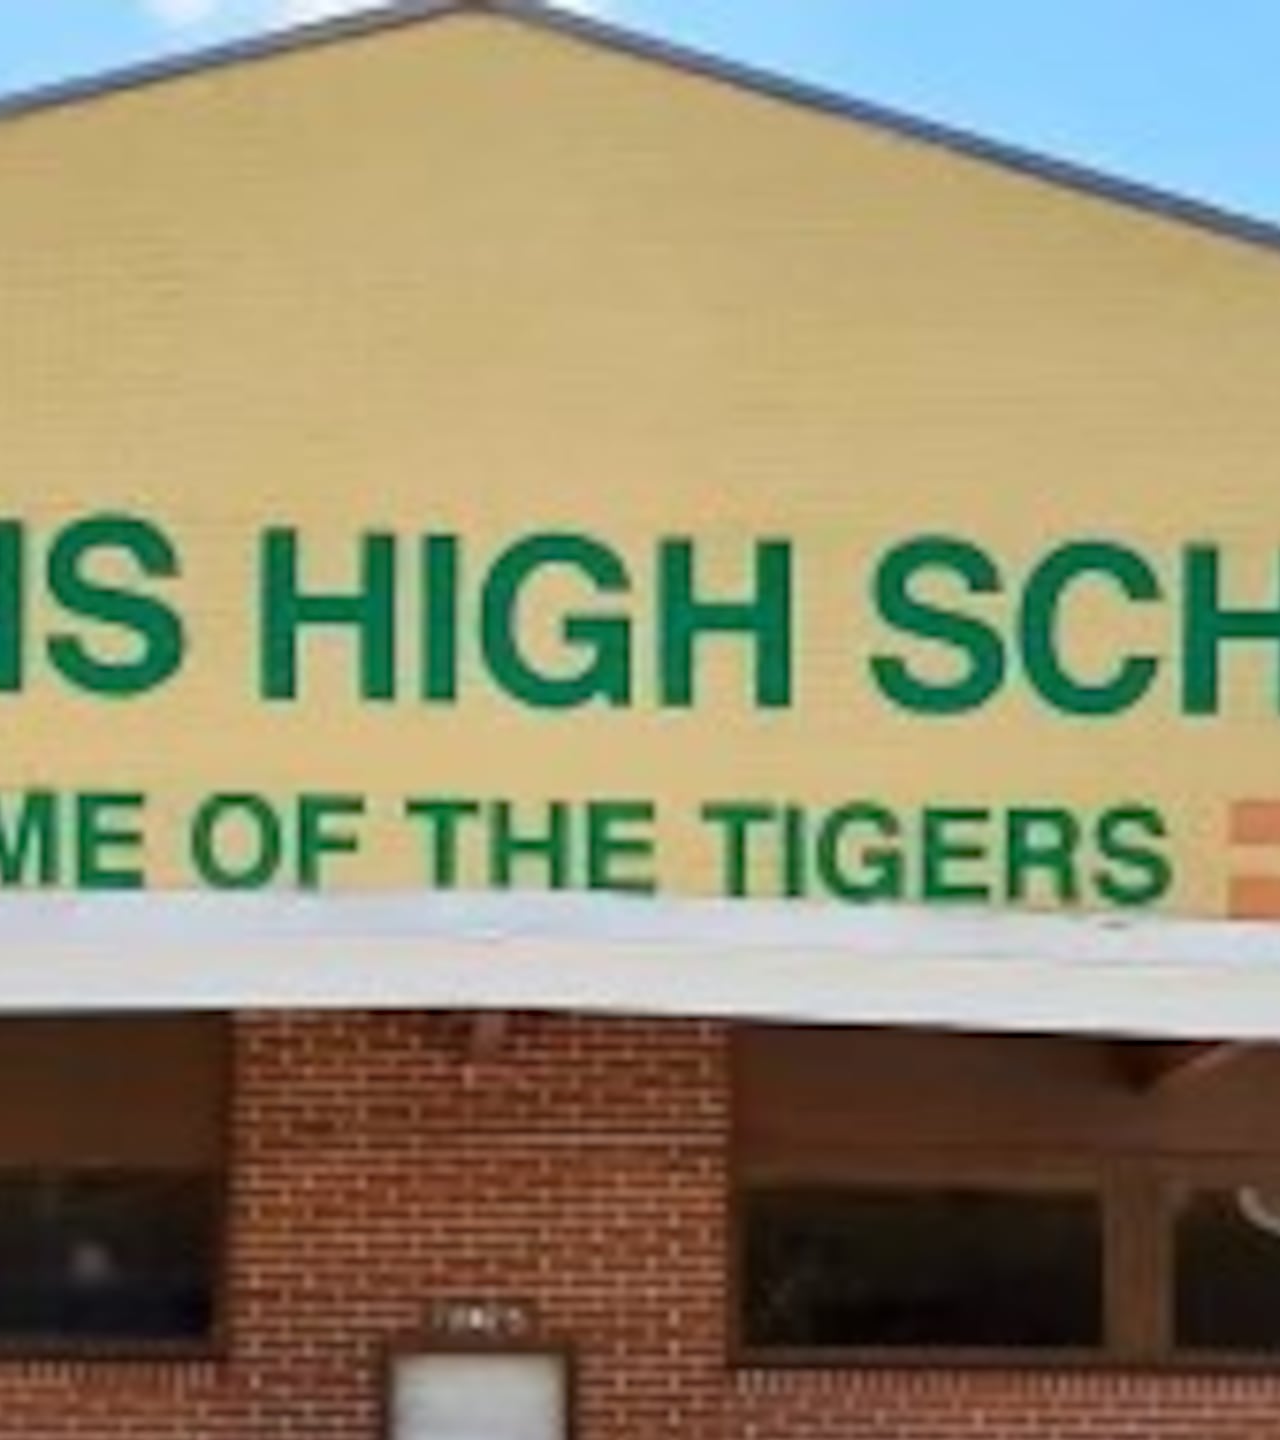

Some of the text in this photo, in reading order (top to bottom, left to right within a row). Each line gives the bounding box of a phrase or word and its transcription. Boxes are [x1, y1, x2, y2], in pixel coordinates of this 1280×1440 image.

[260, 530, 795, 712] HIGH
[190, 793, 366, 892] OF
[405, 799, 656, 893] THE
[704, 803, 1173, 910] TIGERS
